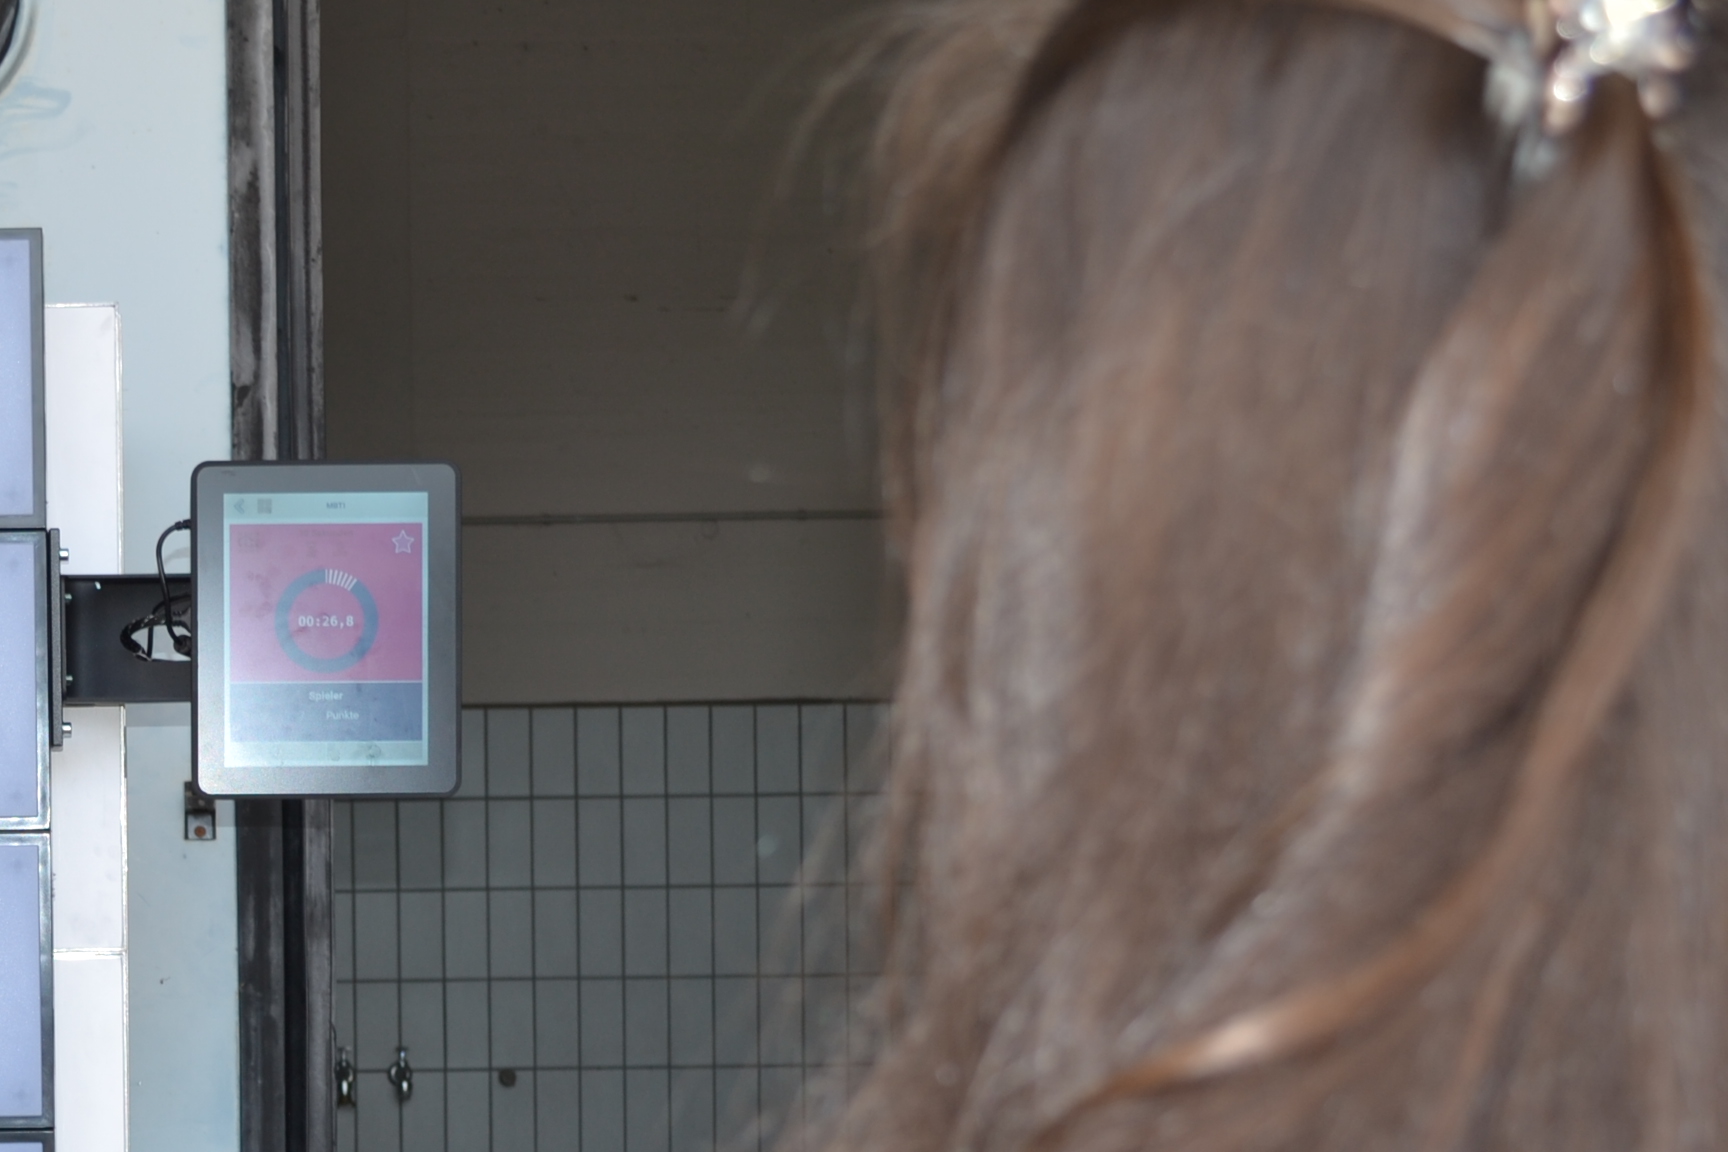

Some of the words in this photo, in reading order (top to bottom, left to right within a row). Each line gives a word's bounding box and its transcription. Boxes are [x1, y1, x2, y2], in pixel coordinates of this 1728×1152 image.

[298, 615, 354, 629] 00:26,8
[308, 690, 344, 702] Spieler
[326, 710, 360, 721] Punkte
